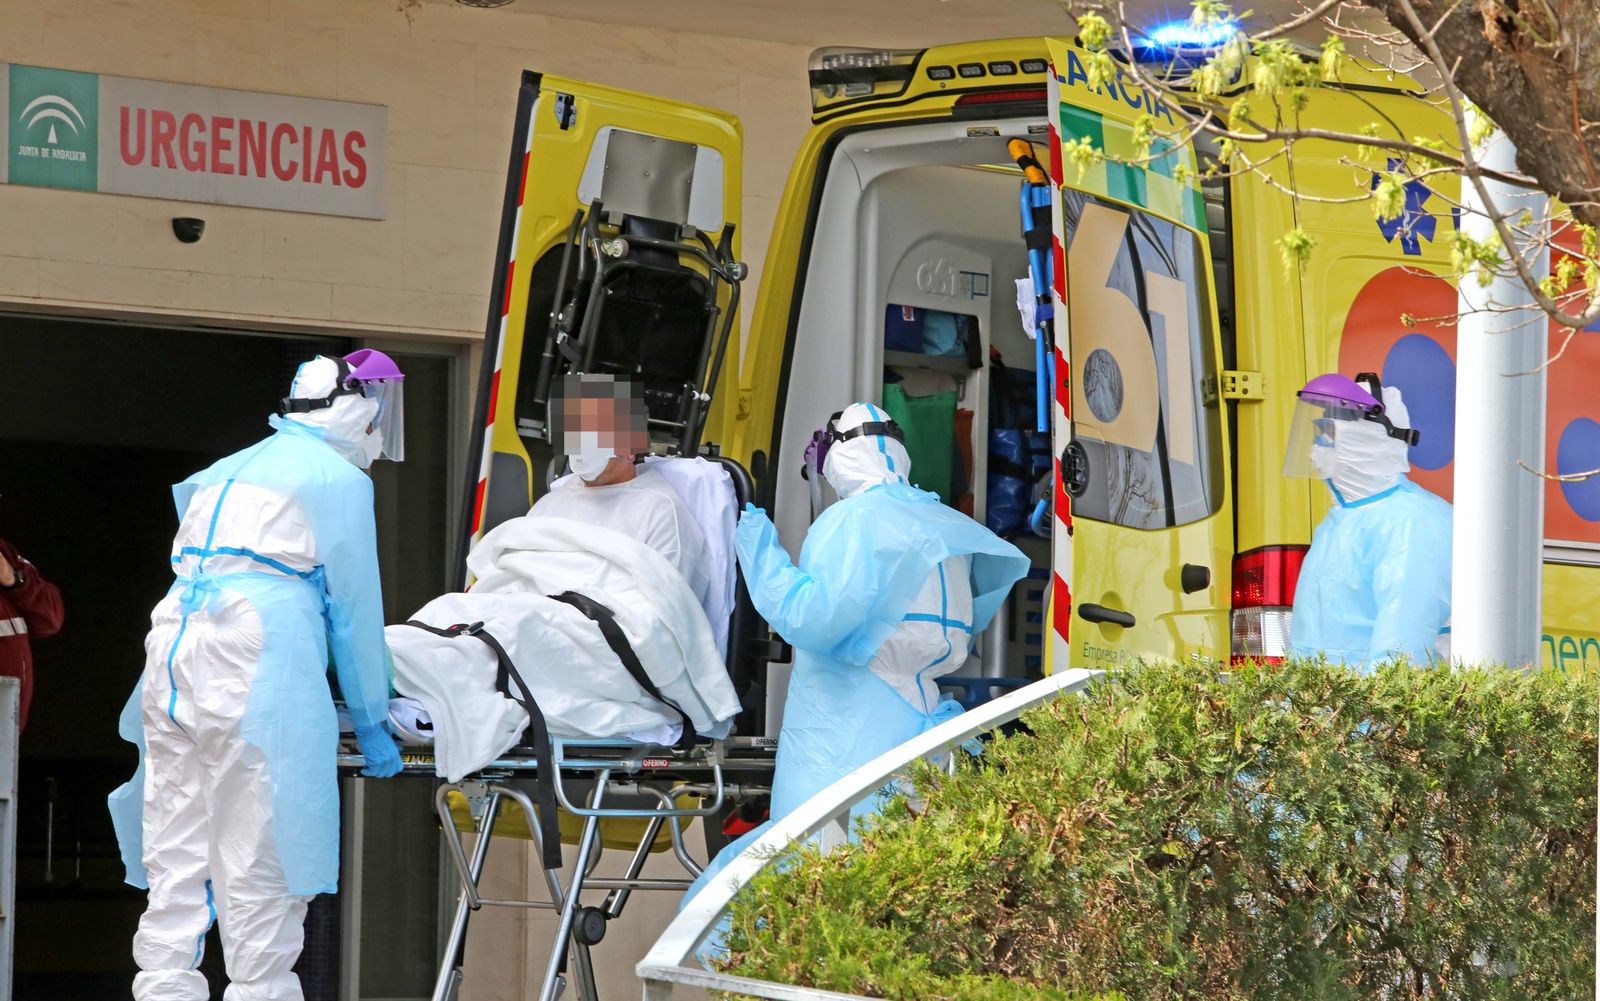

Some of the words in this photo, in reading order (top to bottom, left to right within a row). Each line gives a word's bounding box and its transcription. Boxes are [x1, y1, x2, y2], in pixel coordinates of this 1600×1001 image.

[1057, 49, 1174, 126] ANCIA
[18, 145, 39, 157] JUNTA
[41, 148, 50, 158] DE
[120, 106, 367, 189] URGENCIAS
[1083, 641, 1118, 664] Empresa
[760, 738, 778, 746] FERNO
[648, 759, 668, 767] FERNO
